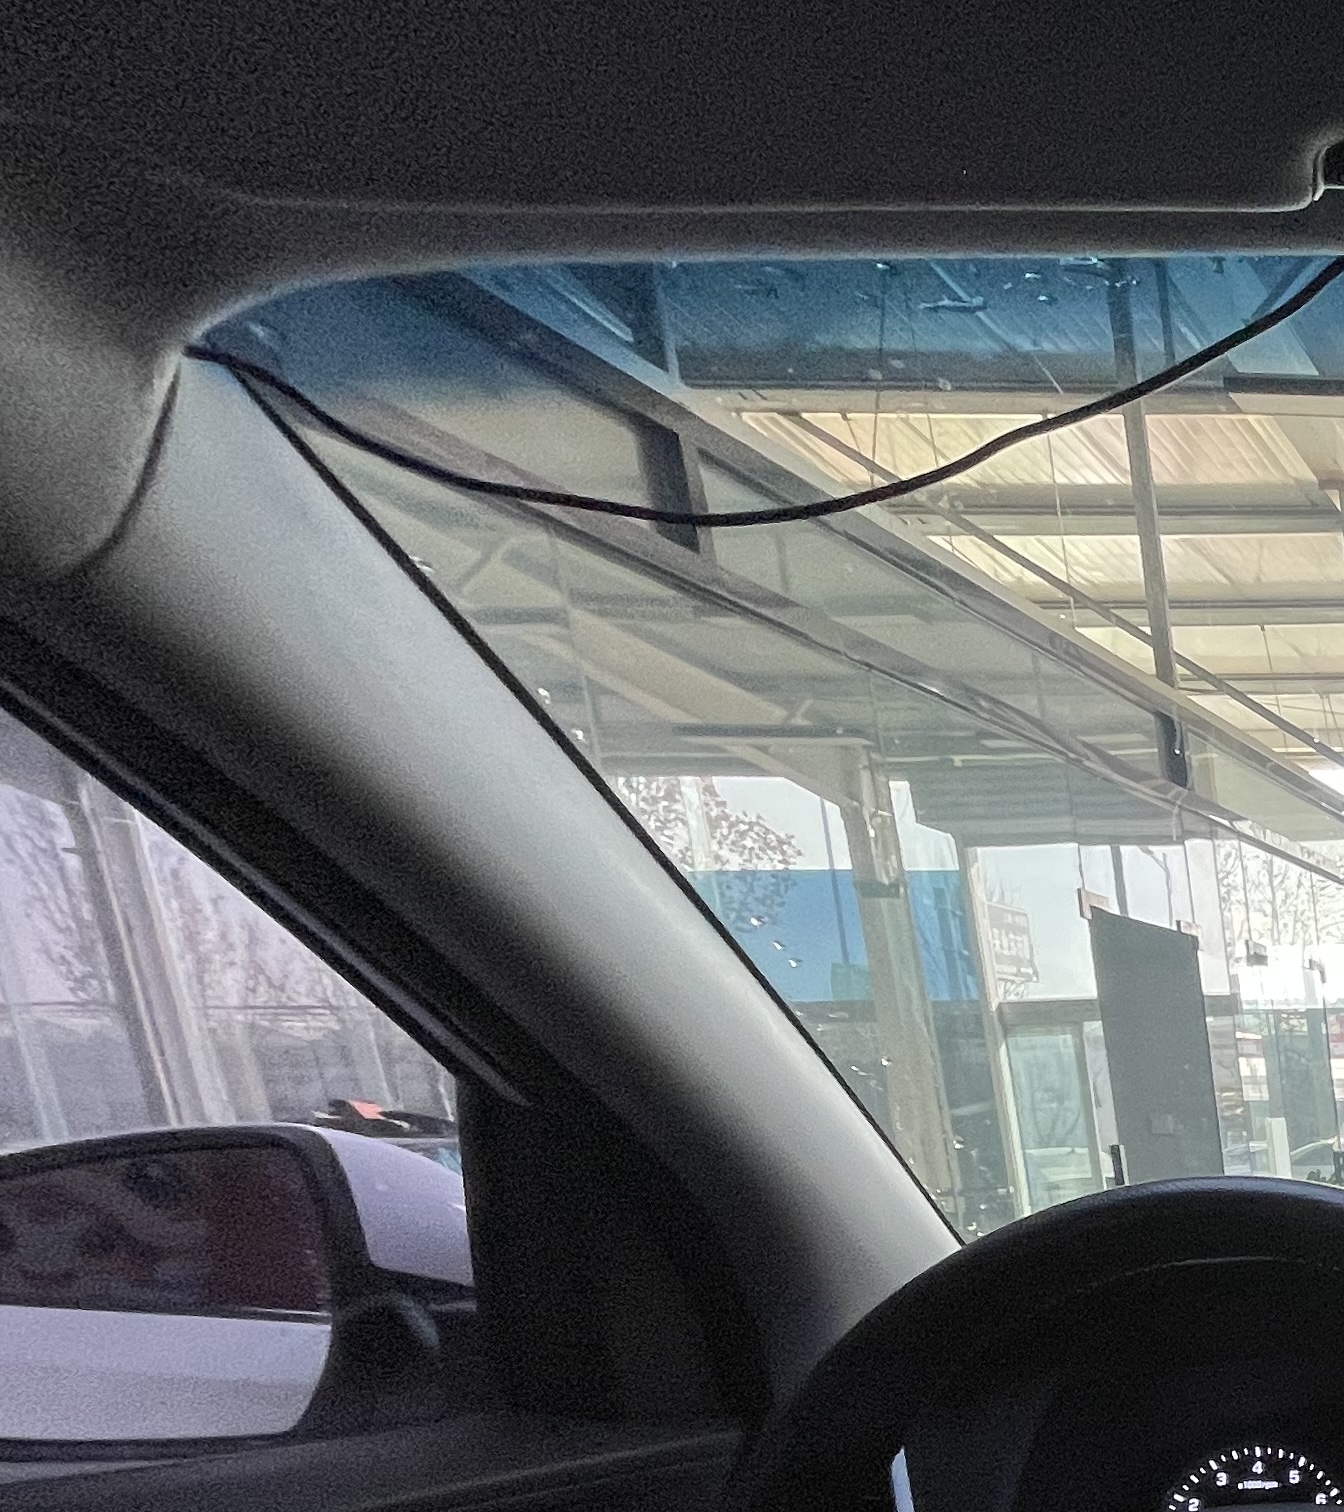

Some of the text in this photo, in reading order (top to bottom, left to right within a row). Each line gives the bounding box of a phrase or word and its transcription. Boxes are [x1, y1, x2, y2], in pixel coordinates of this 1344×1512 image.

[1252, 1461, 1264, 1474] 4
[1216, 1472, 1227, 1486] 3
[1289, 1470, 1300, 1484] 5
[1188, 1498, 1200, 1512] 2
[1316, 1493, 1327, 1505] 6
